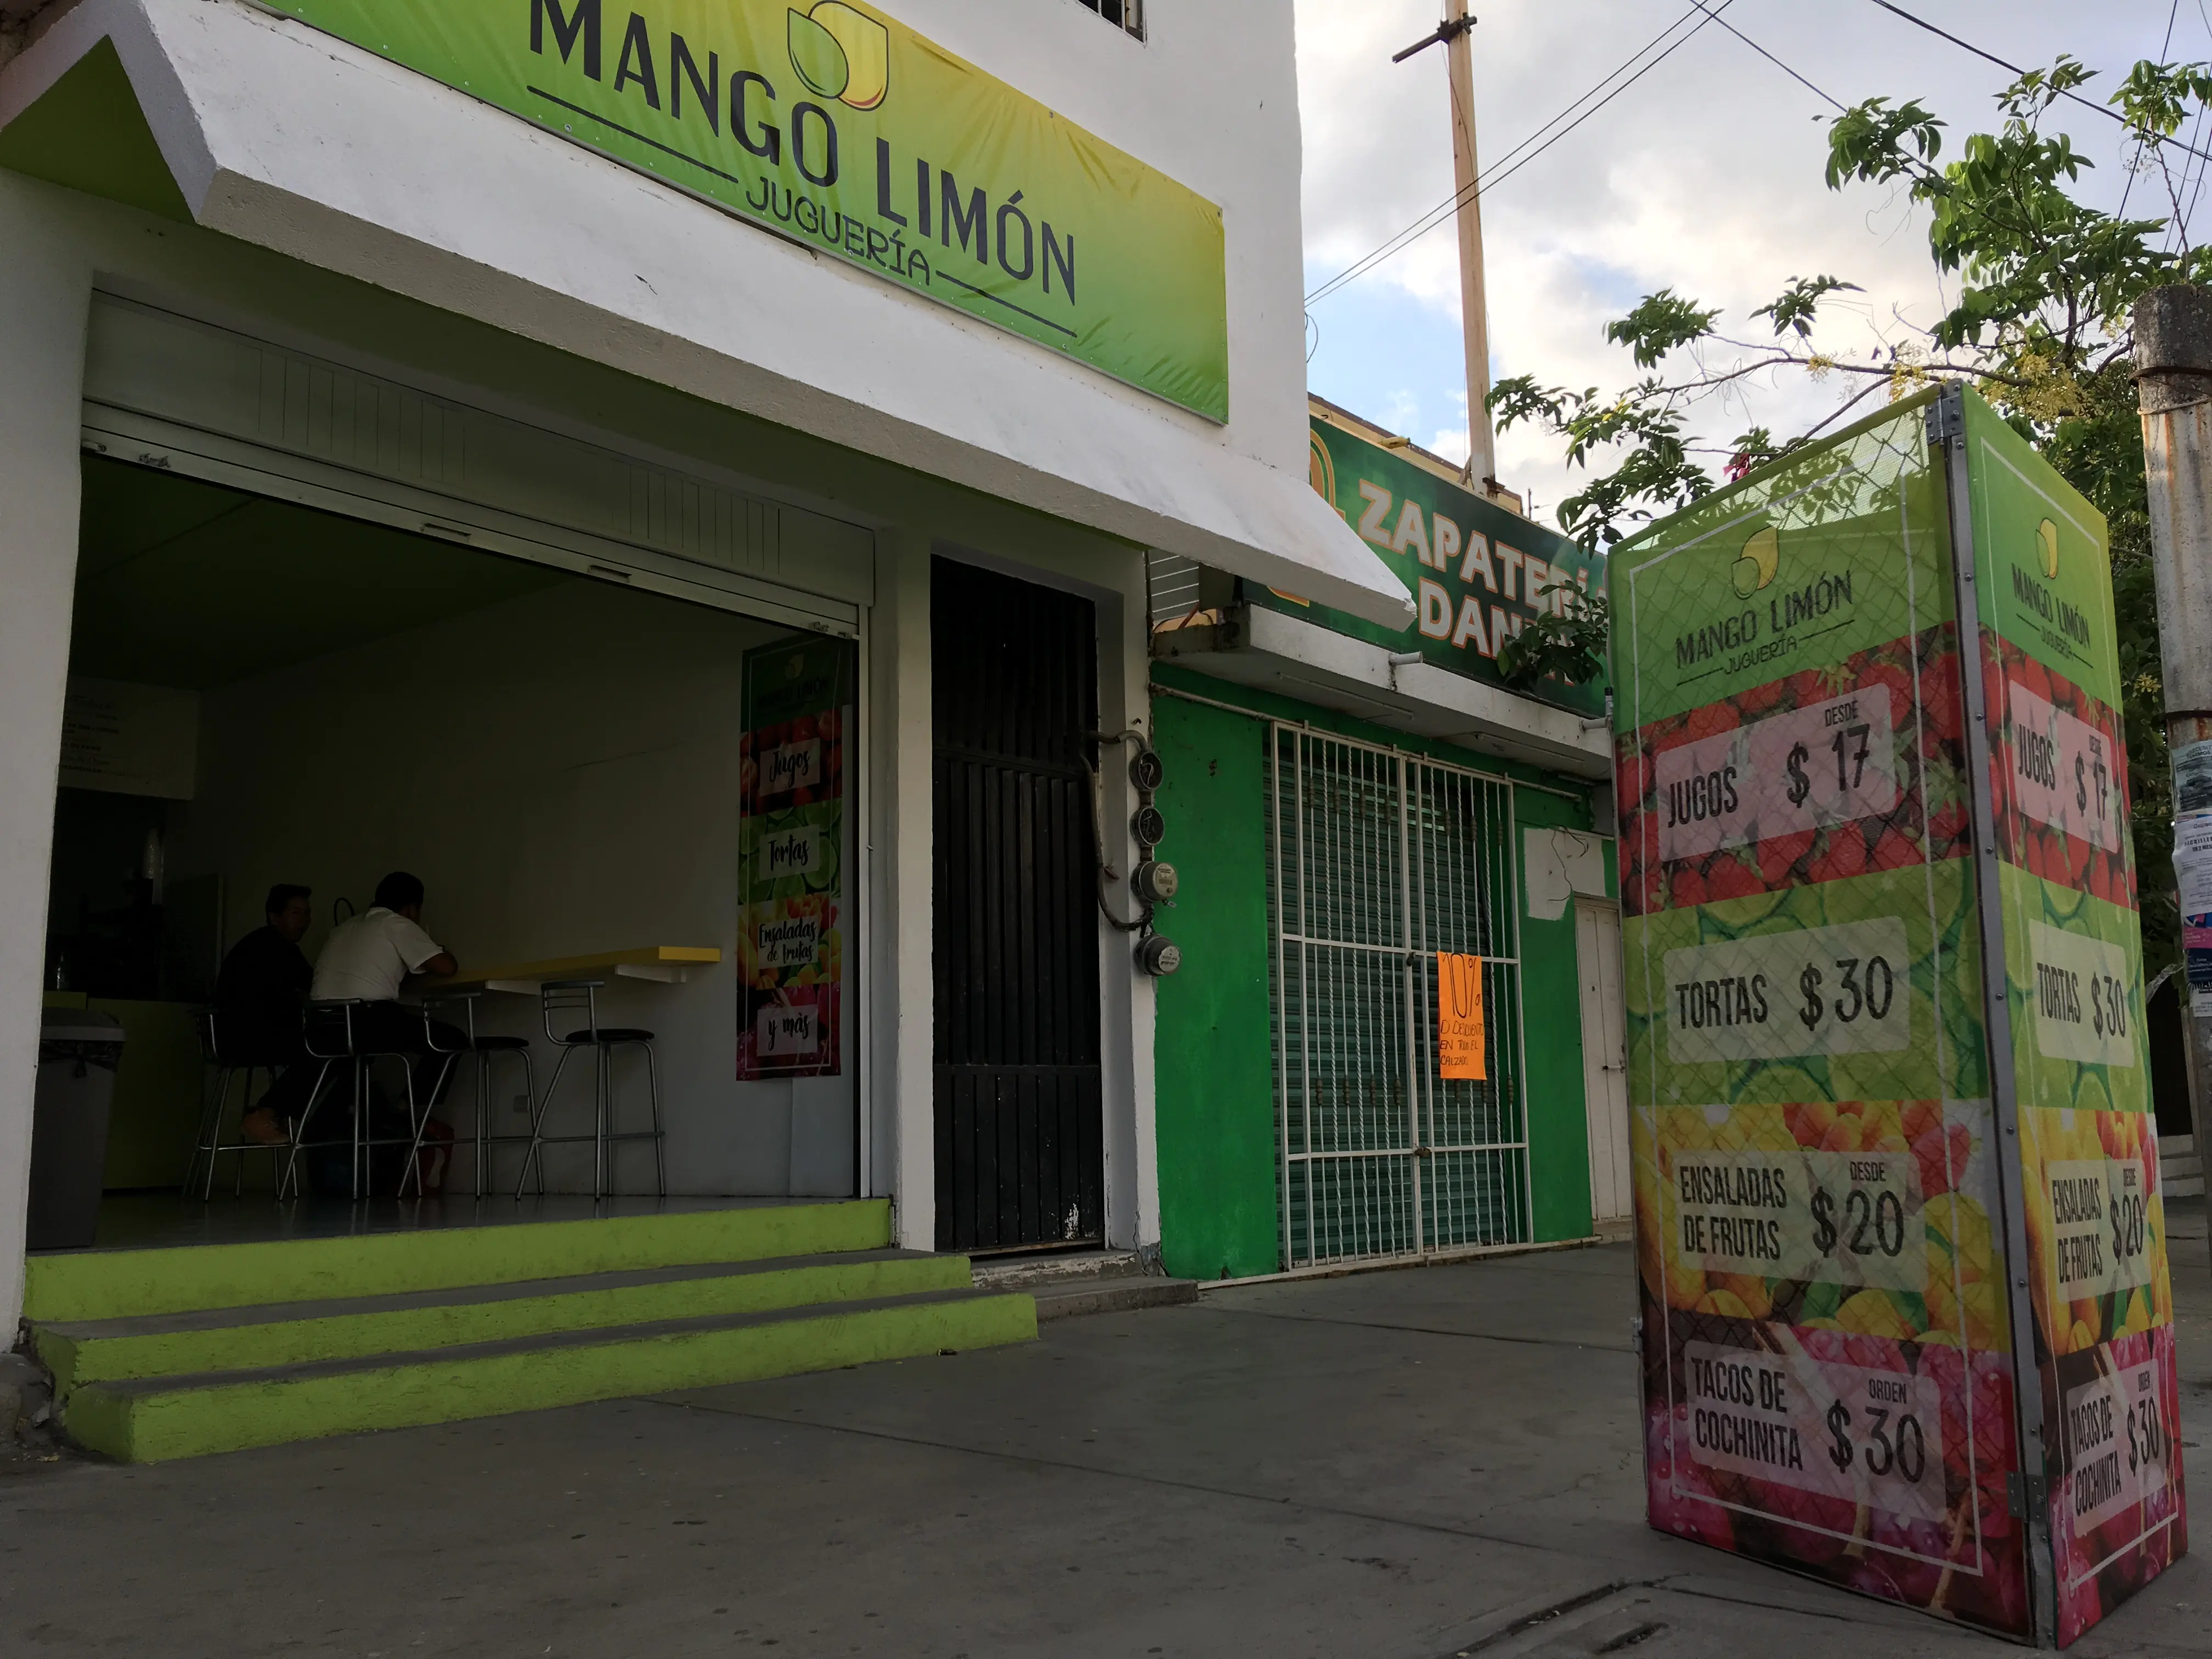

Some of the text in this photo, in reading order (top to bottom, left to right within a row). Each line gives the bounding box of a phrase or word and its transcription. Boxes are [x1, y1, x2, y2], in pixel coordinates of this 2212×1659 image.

[529, 0, 1076, 306] MANGO LIMÓN
[744, 176, 930, 286] JUGUERÍA
[1358, 478, 1608, 627] ZAPATERÍ
[1676, 569, 1853, 669] MANGO LIMÓN
[2012, 562, 2091, 651] MANGO LIMÓN
[1723, 634, 1798, 675] JUGUERÍA
[1825, 699, 1859, 727] DESDE
[769, 751, 811, 788] Jugos
[2017, 723, 2056, 791] JUGOS
[1668, 766, 1739, 828] JUGOS
[768, 834, 810, 872] Tortas
[759, 917, 816, 948] Ensaladas
[767, 941, 814, 964] de frutas
[1675, 974, 1768, 1029] TORTAS
[2036, 962, 2081, 1024] TORTAS
[768, 1020, 777, 1051] y
[1440, 1040, 1453, 1051] EN
[1470, 1039, 1479, 1050] EL
[1440, 1055, 1468, 1066] CALZADO
[1679, 1166, 1787, 1209] ENSALADAS
[1850, 1161, 1886, 1182] DESDE
[2052, 1178, 2102, 1224] ENSALADAS
[1684, 1216, 1781, 1260] DE FRUTAS
[2058, 1233, 2103, 1283] DE FRUTAS
[1691, 1357, 1787, 1414] TACOS DE
[1869, 1377, 1907, 1405] ORDEN
[1695, 1408, 1803, 1471] COCHINITA
[2070, 1395, 2114, 1455] TACOS DE
[2075, 1450, 2122, 1516] COCHINITA
